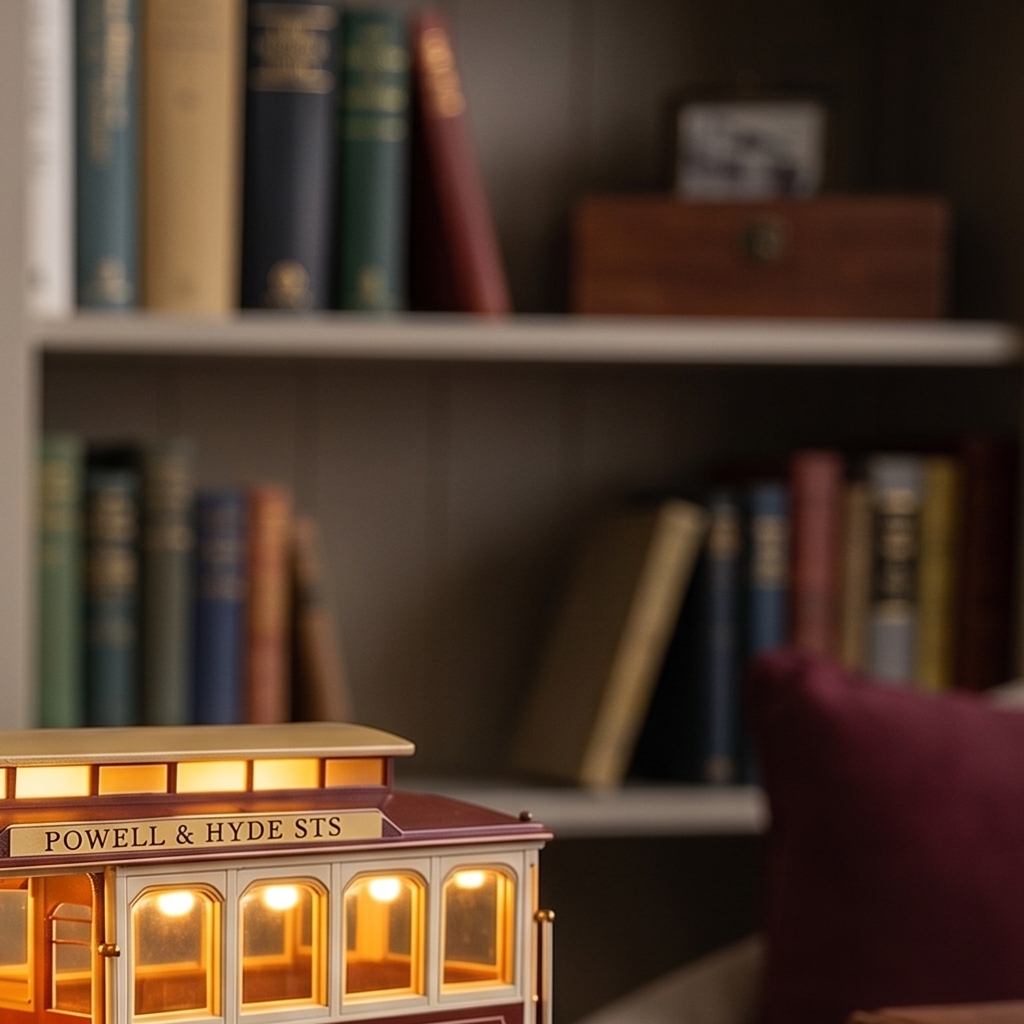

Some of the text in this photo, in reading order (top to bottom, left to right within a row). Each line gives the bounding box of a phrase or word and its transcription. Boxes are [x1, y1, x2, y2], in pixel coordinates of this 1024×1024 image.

[45, 817, 341, 852] POWELL & HYDE STS
